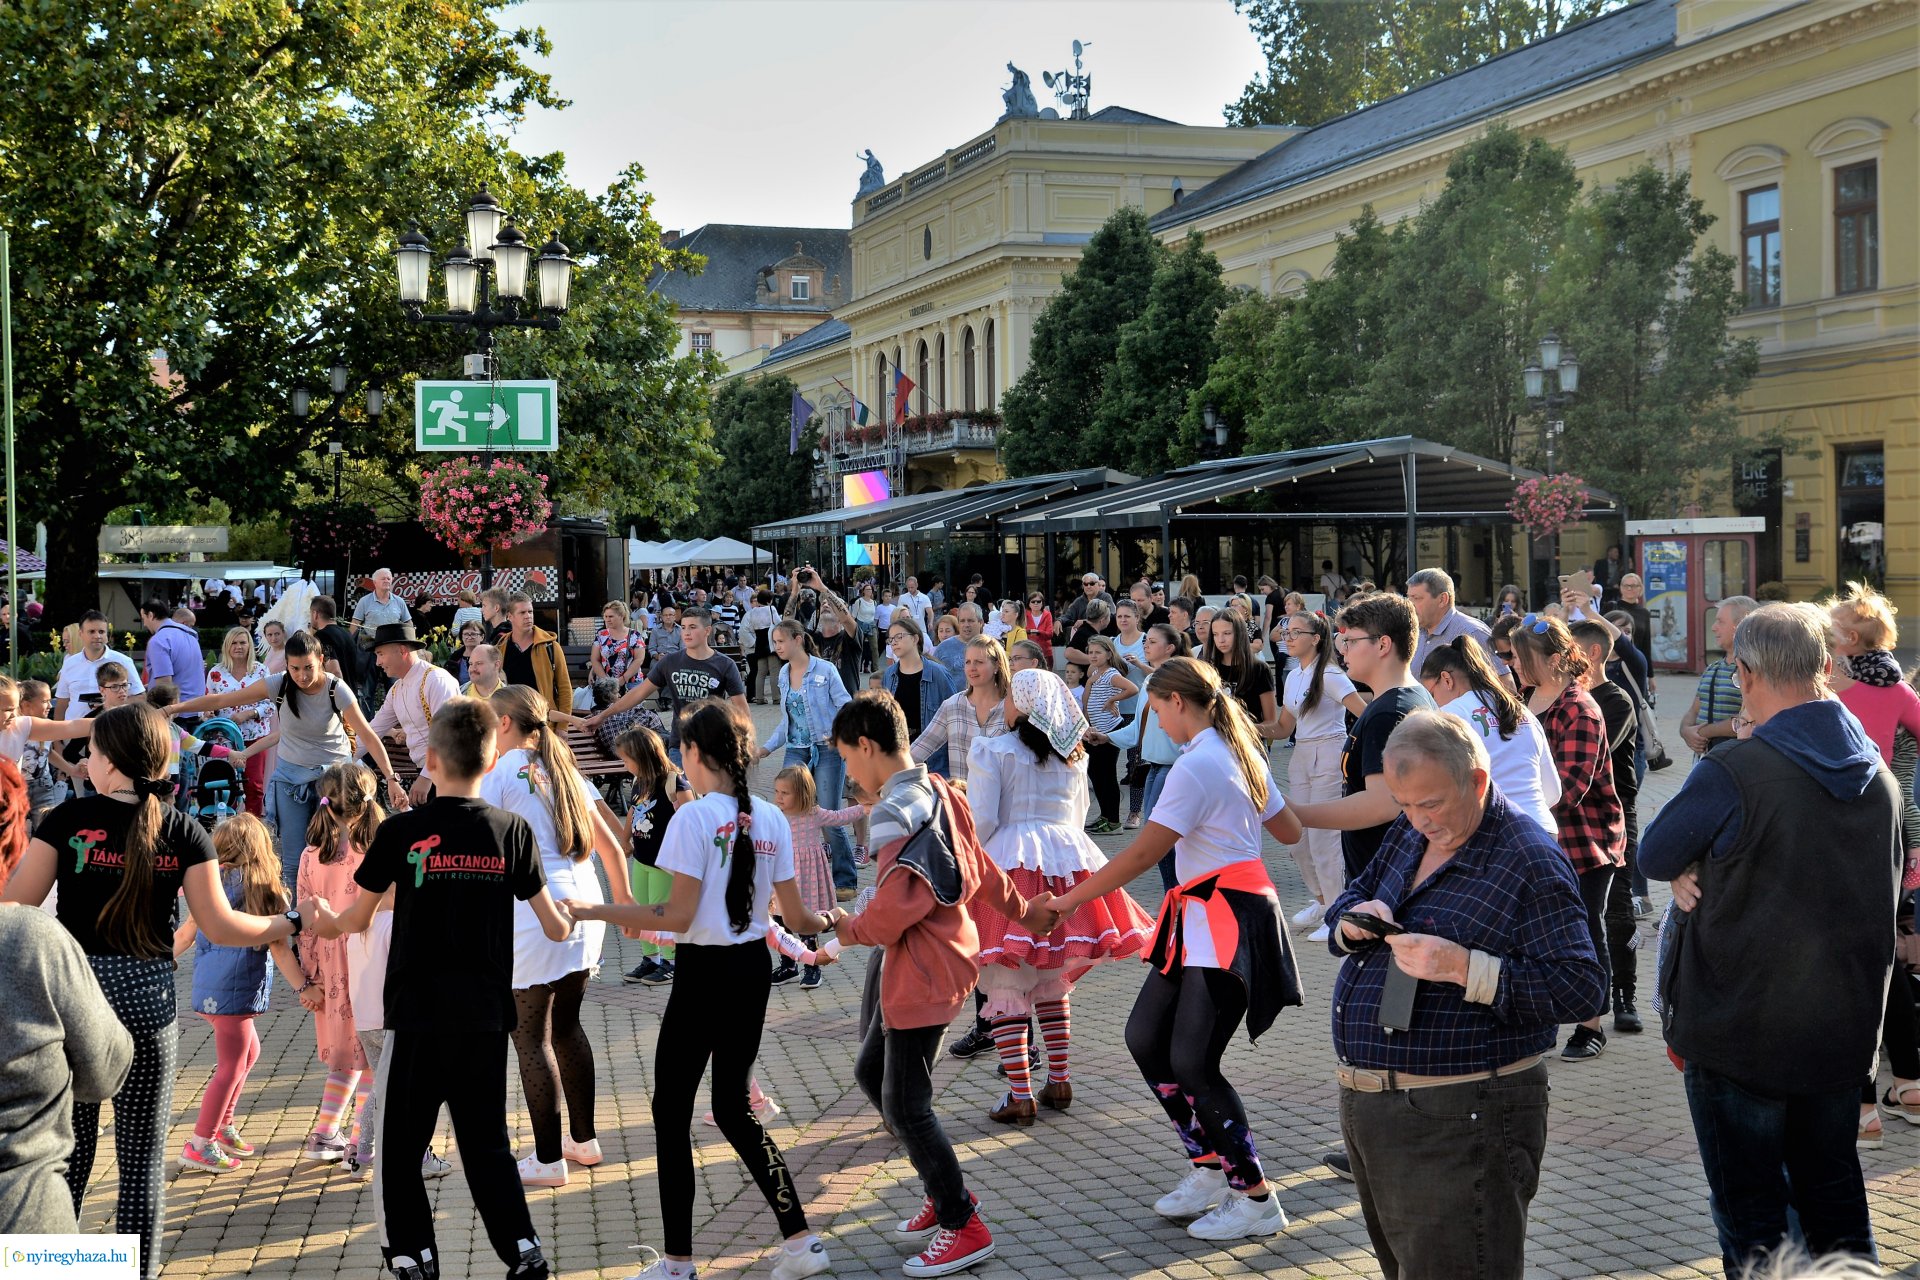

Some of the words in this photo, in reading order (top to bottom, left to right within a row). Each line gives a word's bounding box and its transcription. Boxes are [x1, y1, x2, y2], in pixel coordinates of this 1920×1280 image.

[120, 529, 143, 546] 383
[676, 684, 709, 699] WIND
[428, 852, 506, 870] TÁNCTANODA
